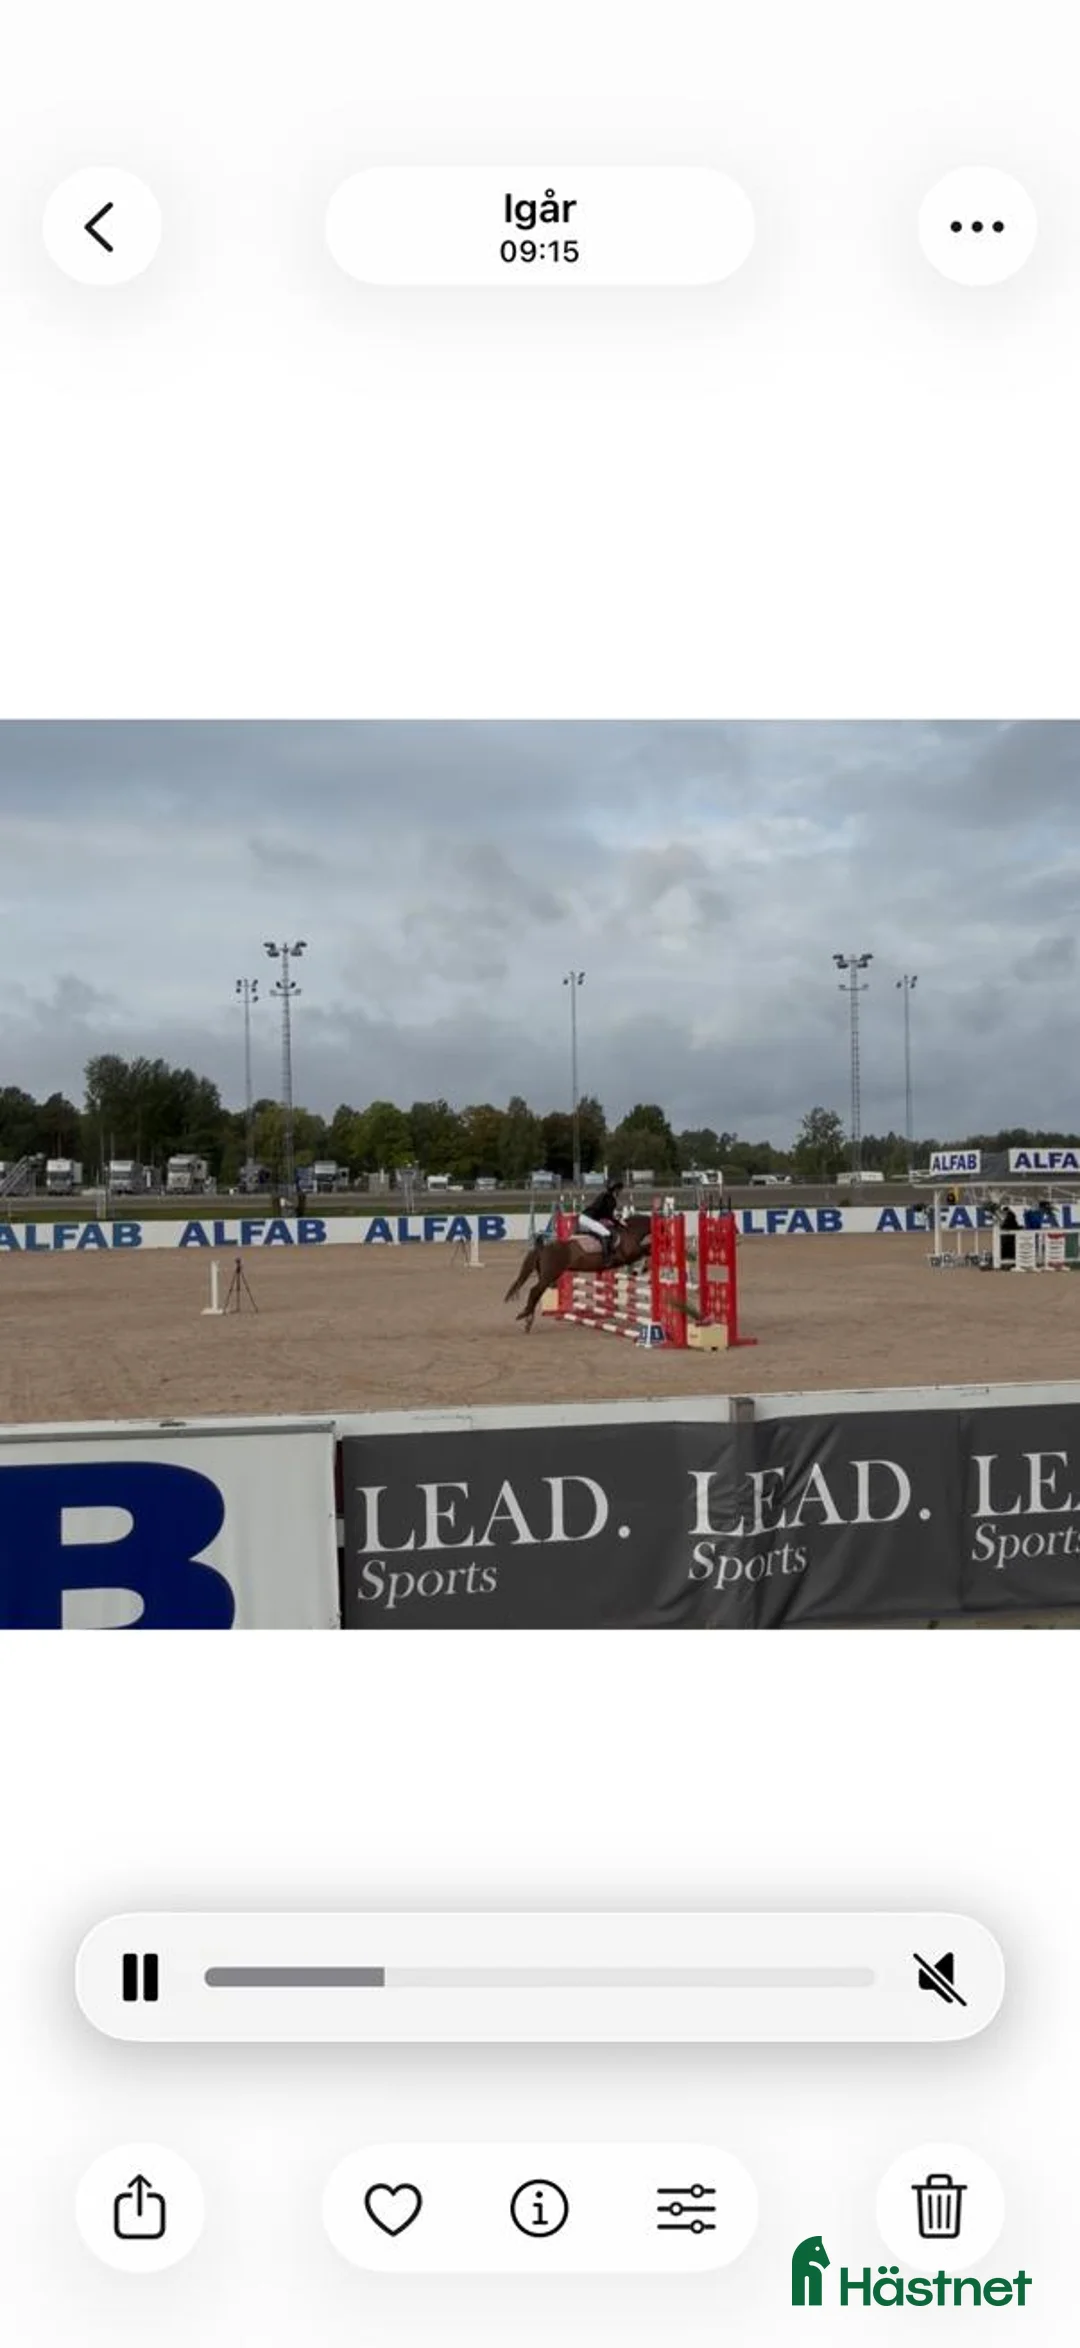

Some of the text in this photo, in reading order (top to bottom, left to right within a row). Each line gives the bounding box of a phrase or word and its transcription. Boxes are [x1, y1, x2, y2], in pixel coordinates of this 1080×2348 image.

[504, 188, 577, 230] Igår
[500, 239, 579, 262] 09:15
[932, 1153, 977, 1171] ALFAB
[1014, 1152, 1079, 1169] ALFA
[178, 1219, 327, 1248] ALFAB
[364, 1216, 507, 1244] ALFAB
[735, 1208, 843, 1234] LFAB
[687, 1459, 932, 1537] LEAD.
[971, 1451, 1080, 1518] LE
[356, 1475, 631, 1554] LEAD.
[687, 1541, 807, 1590] Sports
[357, 1560, 498, 1609] Sports
